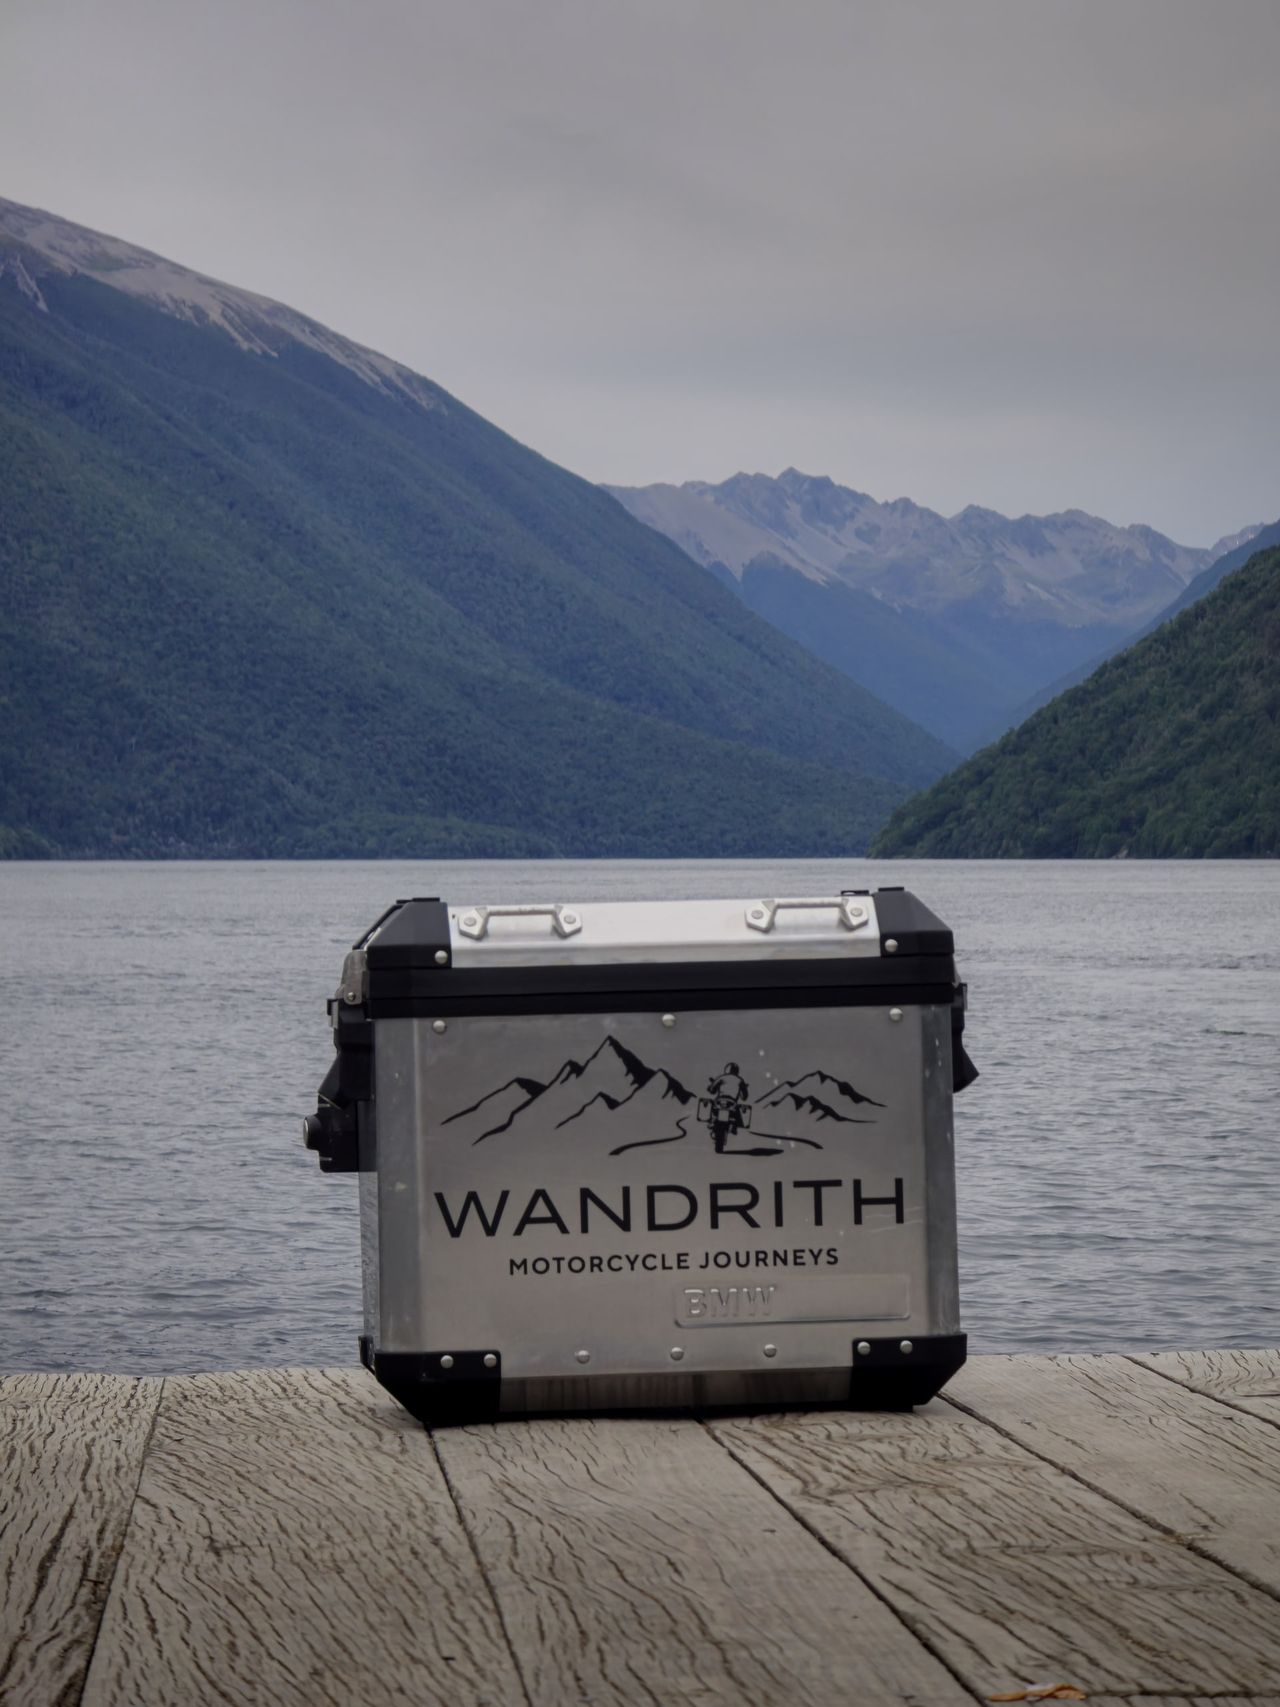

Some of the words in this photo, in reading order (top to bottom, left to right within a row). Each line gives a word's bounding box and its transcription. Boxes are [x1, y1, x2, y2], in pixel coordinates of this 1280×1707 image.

[433, 1177, 905, 1238] WANDRITH
[508, 1252, 691, 1276] MOTORCYCLE
[698, 1247, 840, 1270] JOURNEYS
[684, 1286, 776, 1318] BMW
